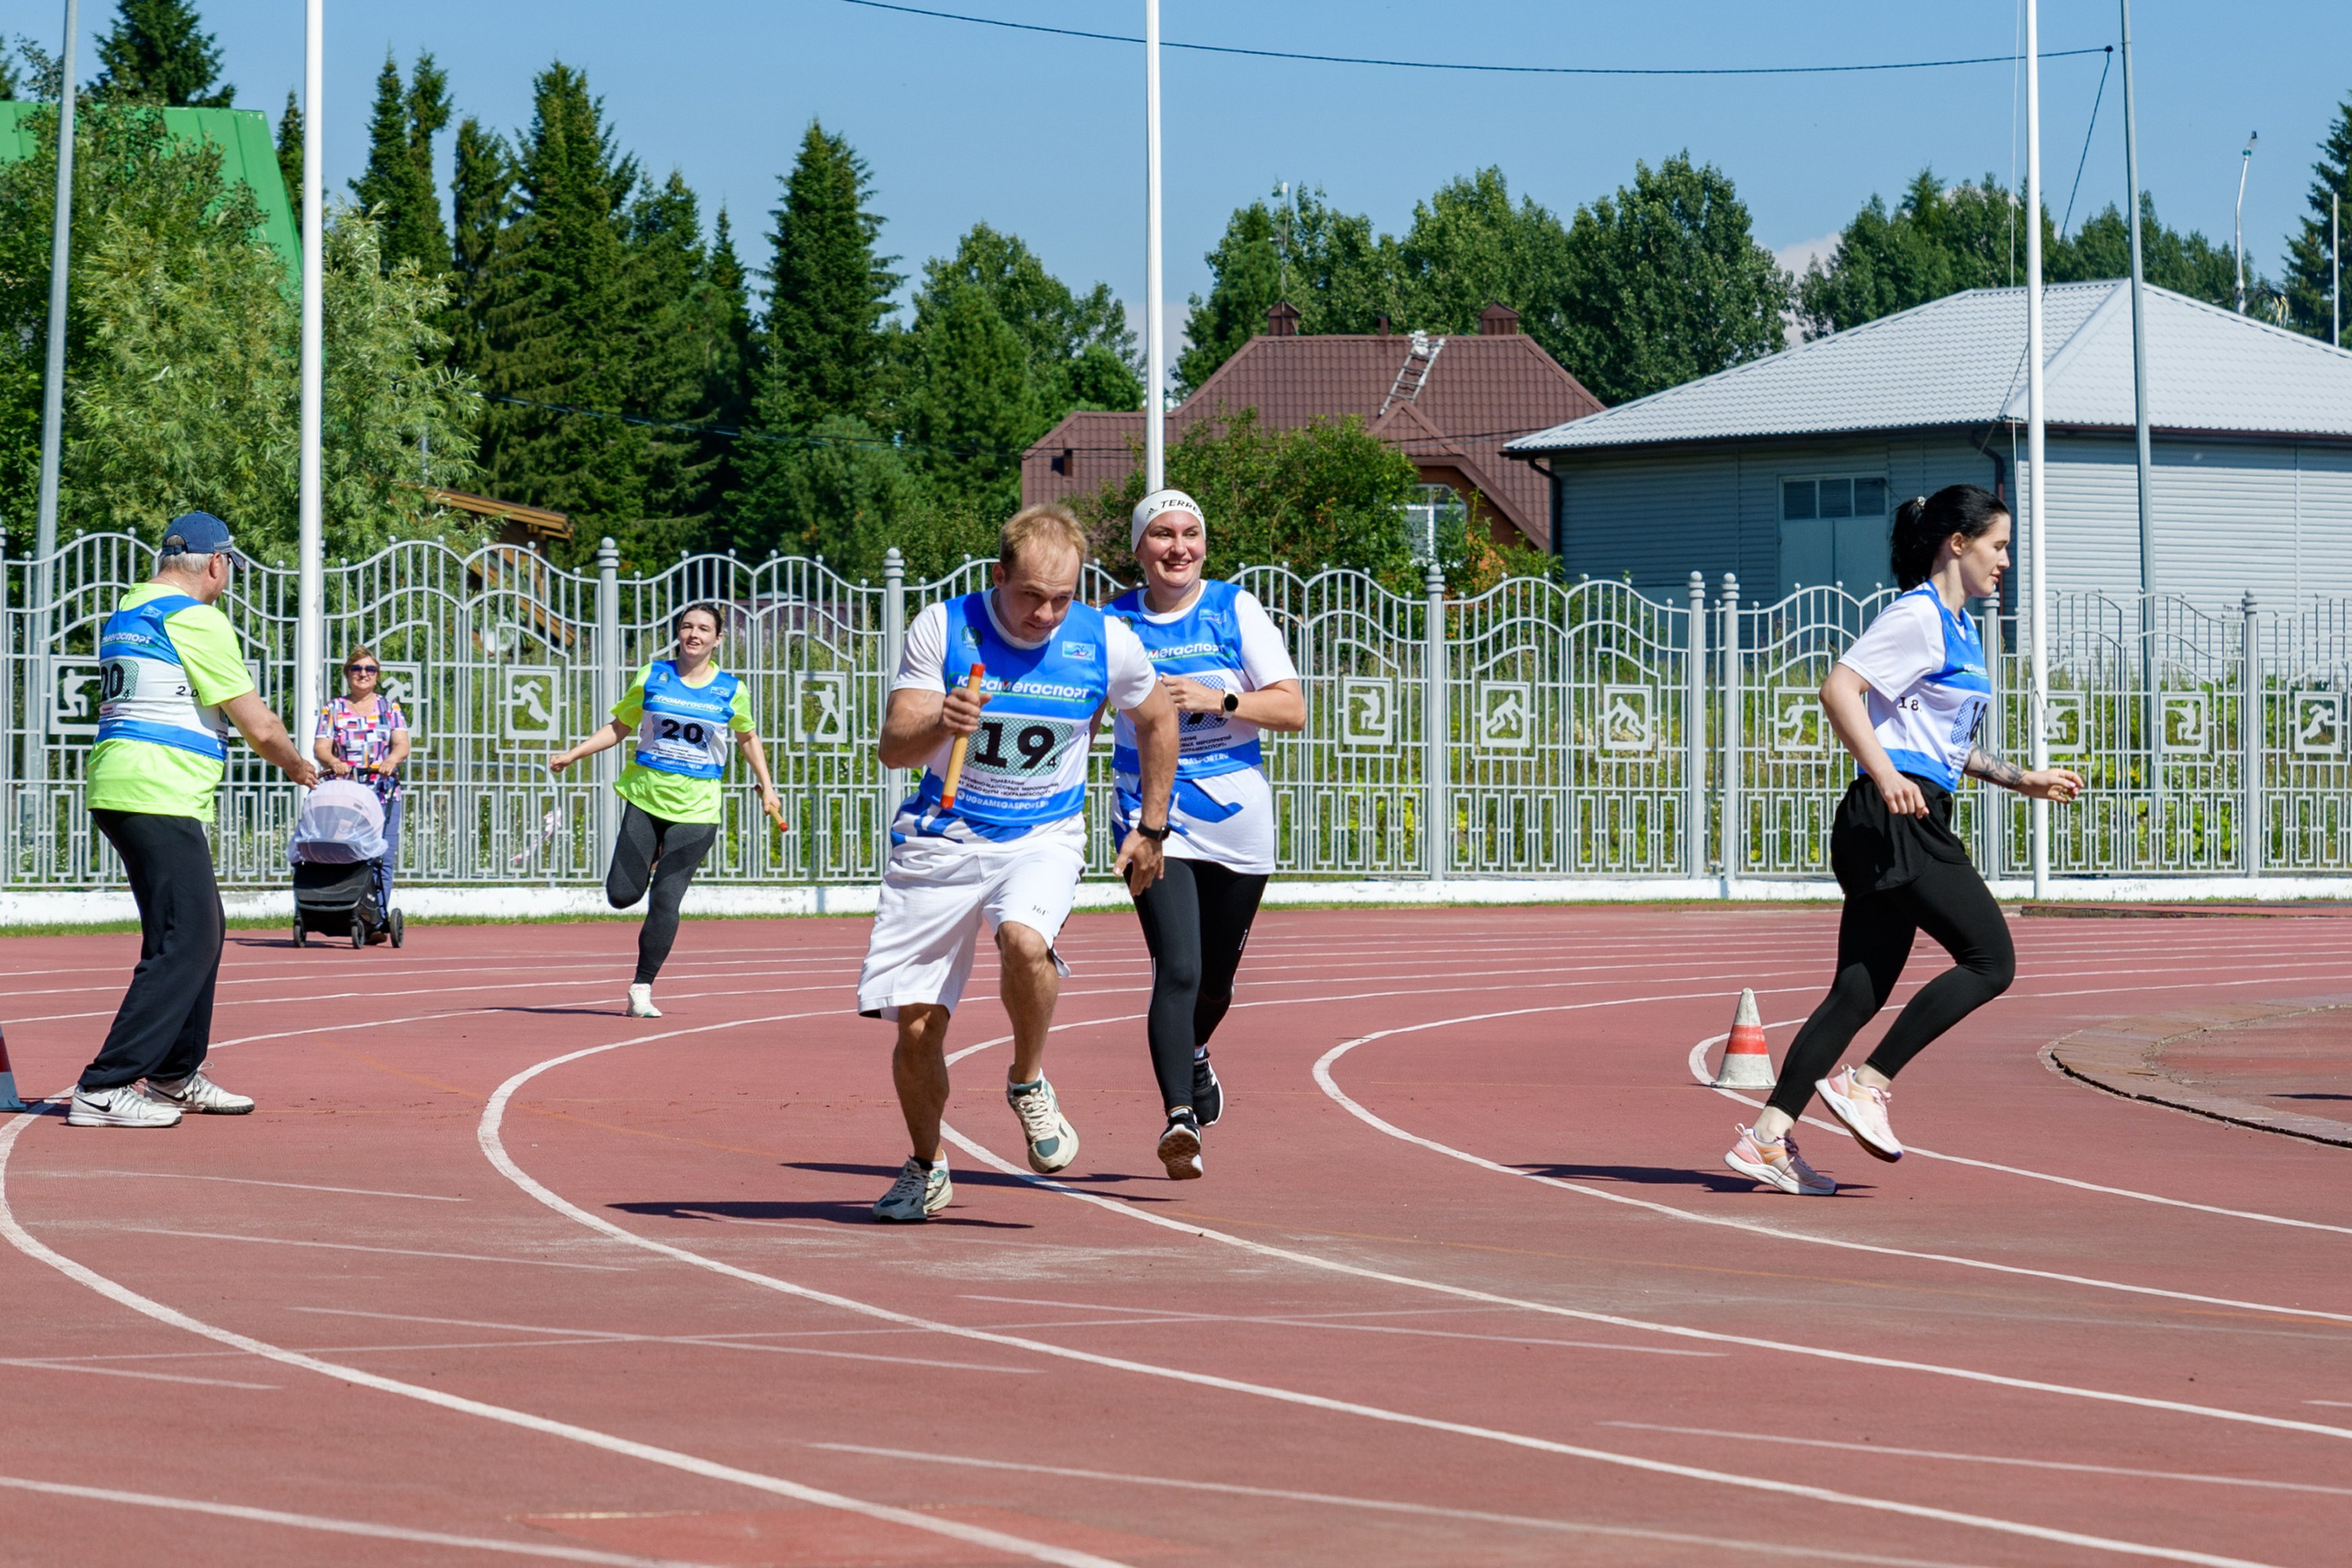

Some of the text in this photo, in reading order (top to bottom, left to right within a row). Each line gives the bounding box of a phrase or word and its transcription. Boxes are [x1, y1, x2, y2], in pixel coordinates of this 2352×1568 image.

[100, 663, 125, 702] 20
[662, 719, 705, 745] 20
[974, 721, 1056, 769] 19
[1046, 754, 1057, 769] 4
